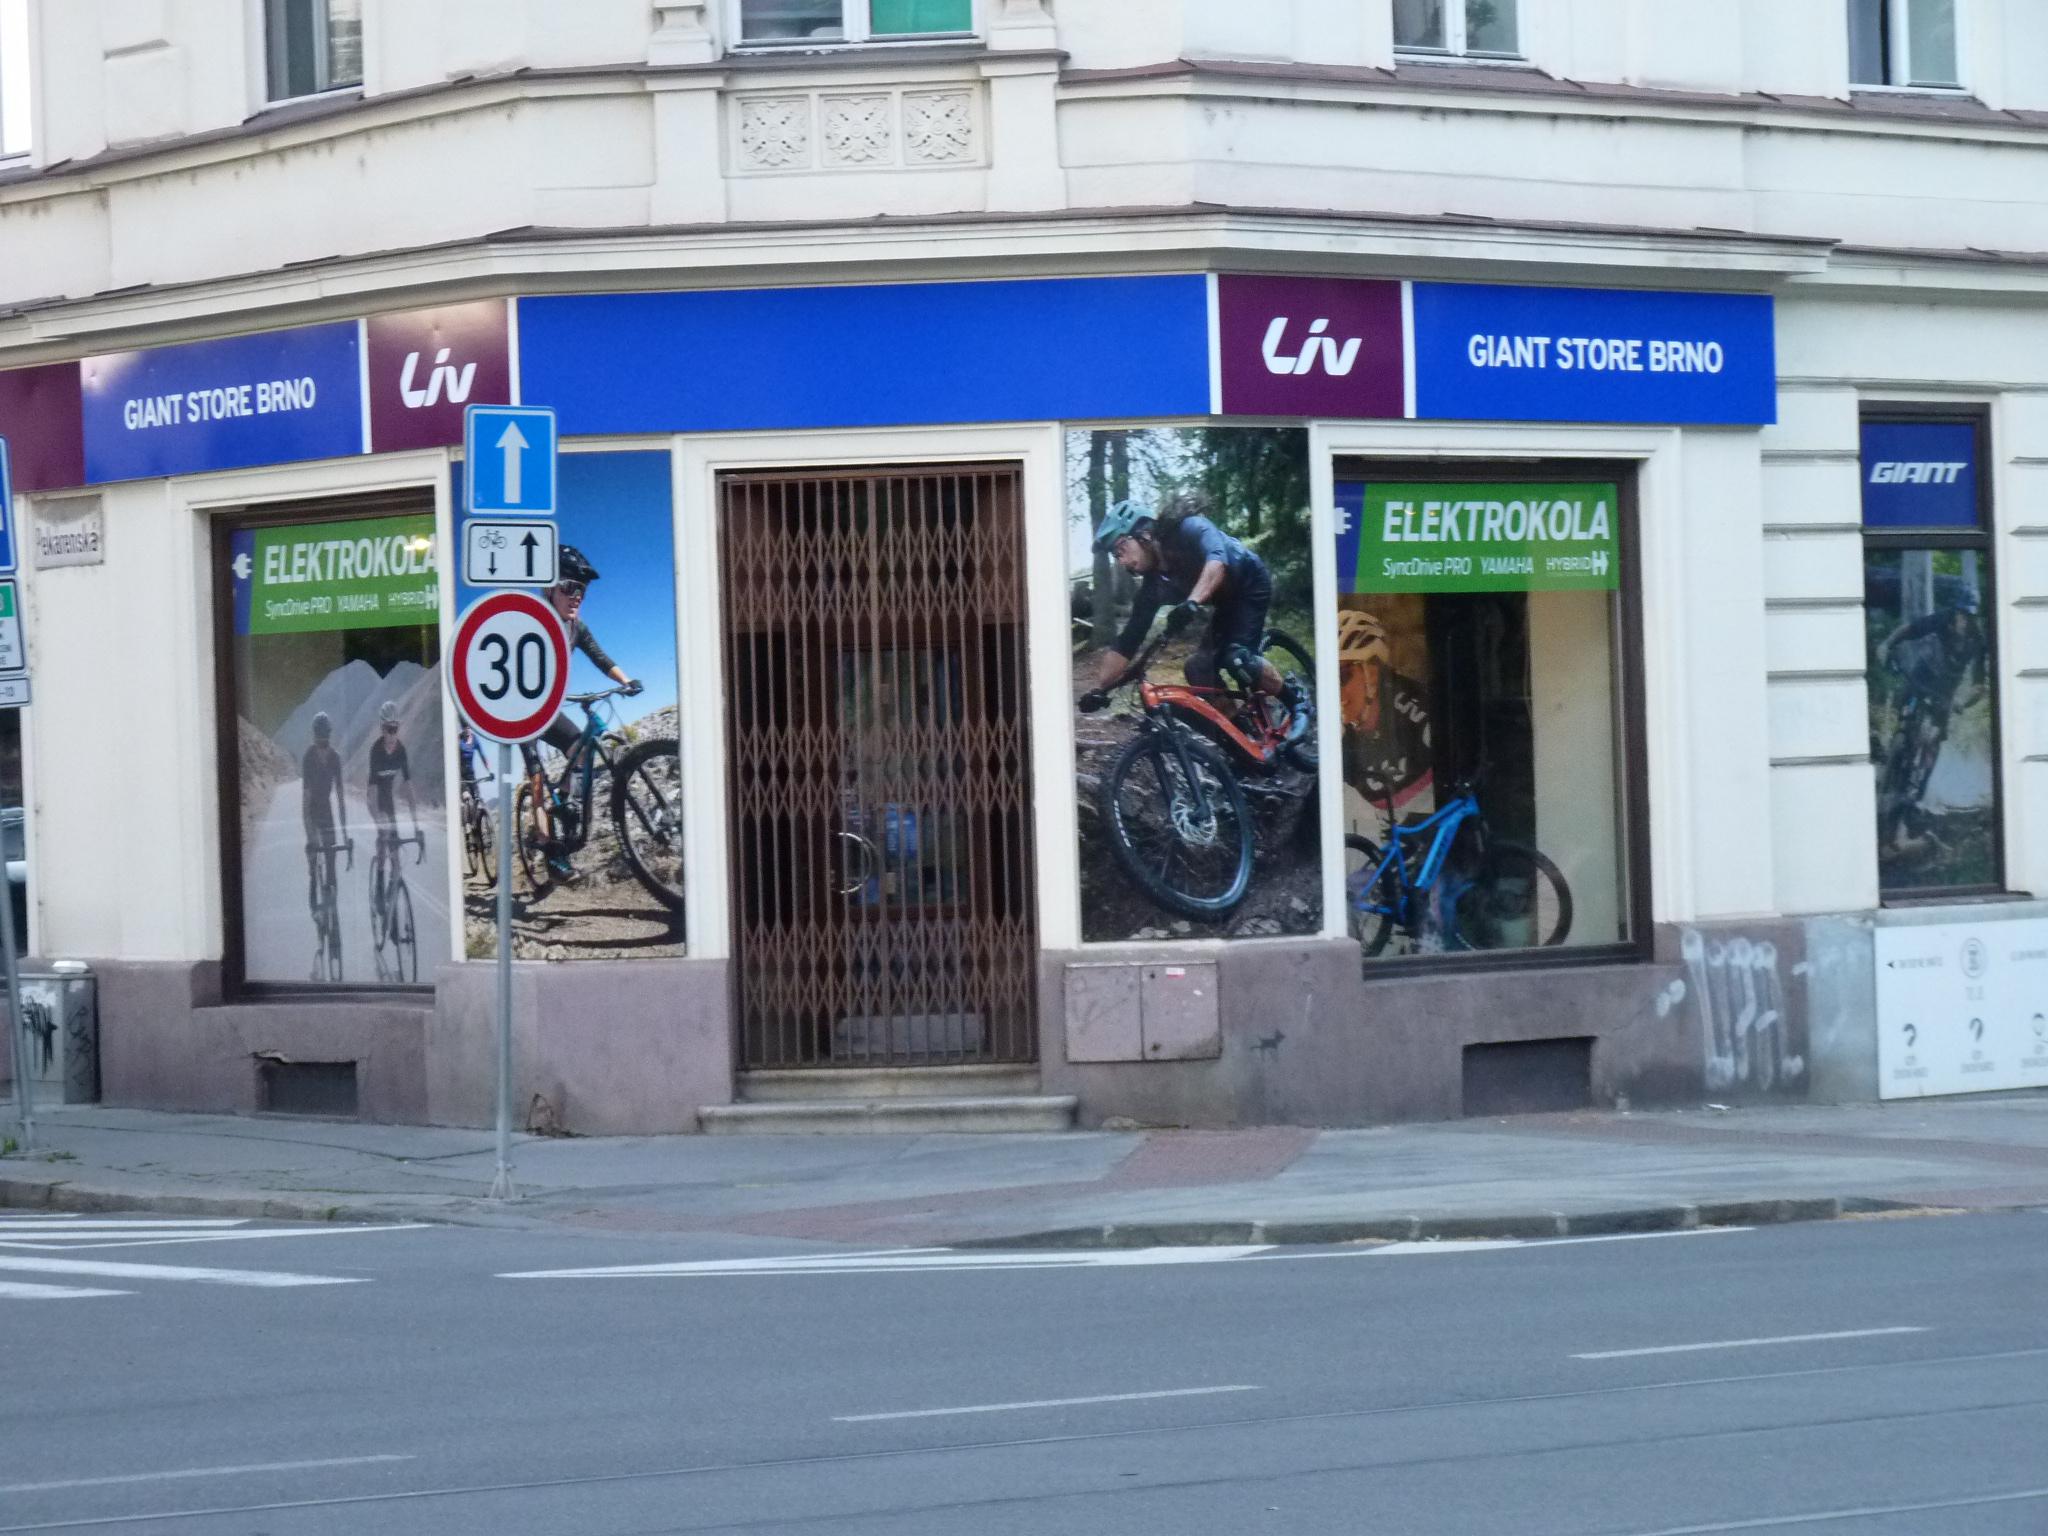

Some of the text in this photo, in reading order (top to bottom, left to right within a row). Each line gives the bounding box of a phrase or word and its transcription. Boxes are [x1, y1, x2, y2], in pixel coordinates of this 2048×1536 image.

[1260, 316, 1363, 376] Liv
[1467, 334, 1724, 374] GIANT STORE BRNO
[400, 347, 477, 408] Liv
[124, 376, 316, 430] GIANT STORE BRNO
[1868, 461, 1969, 484] GIANT
[1382, 500, 1611, 543] ELEKTROKOLA
[263, 532, 438, 585] ELEKTROKOLA
[1382, 556, 1442, 579] SyncDrive
[1443, 557, 1473, 576] PRO
[1480, 556, 1535, 575] YAMAHA
[311, 595, 333, 615] PRO
[336, 592, 381, 614] YAMAHA
[478, 631, 547, 701] 30
